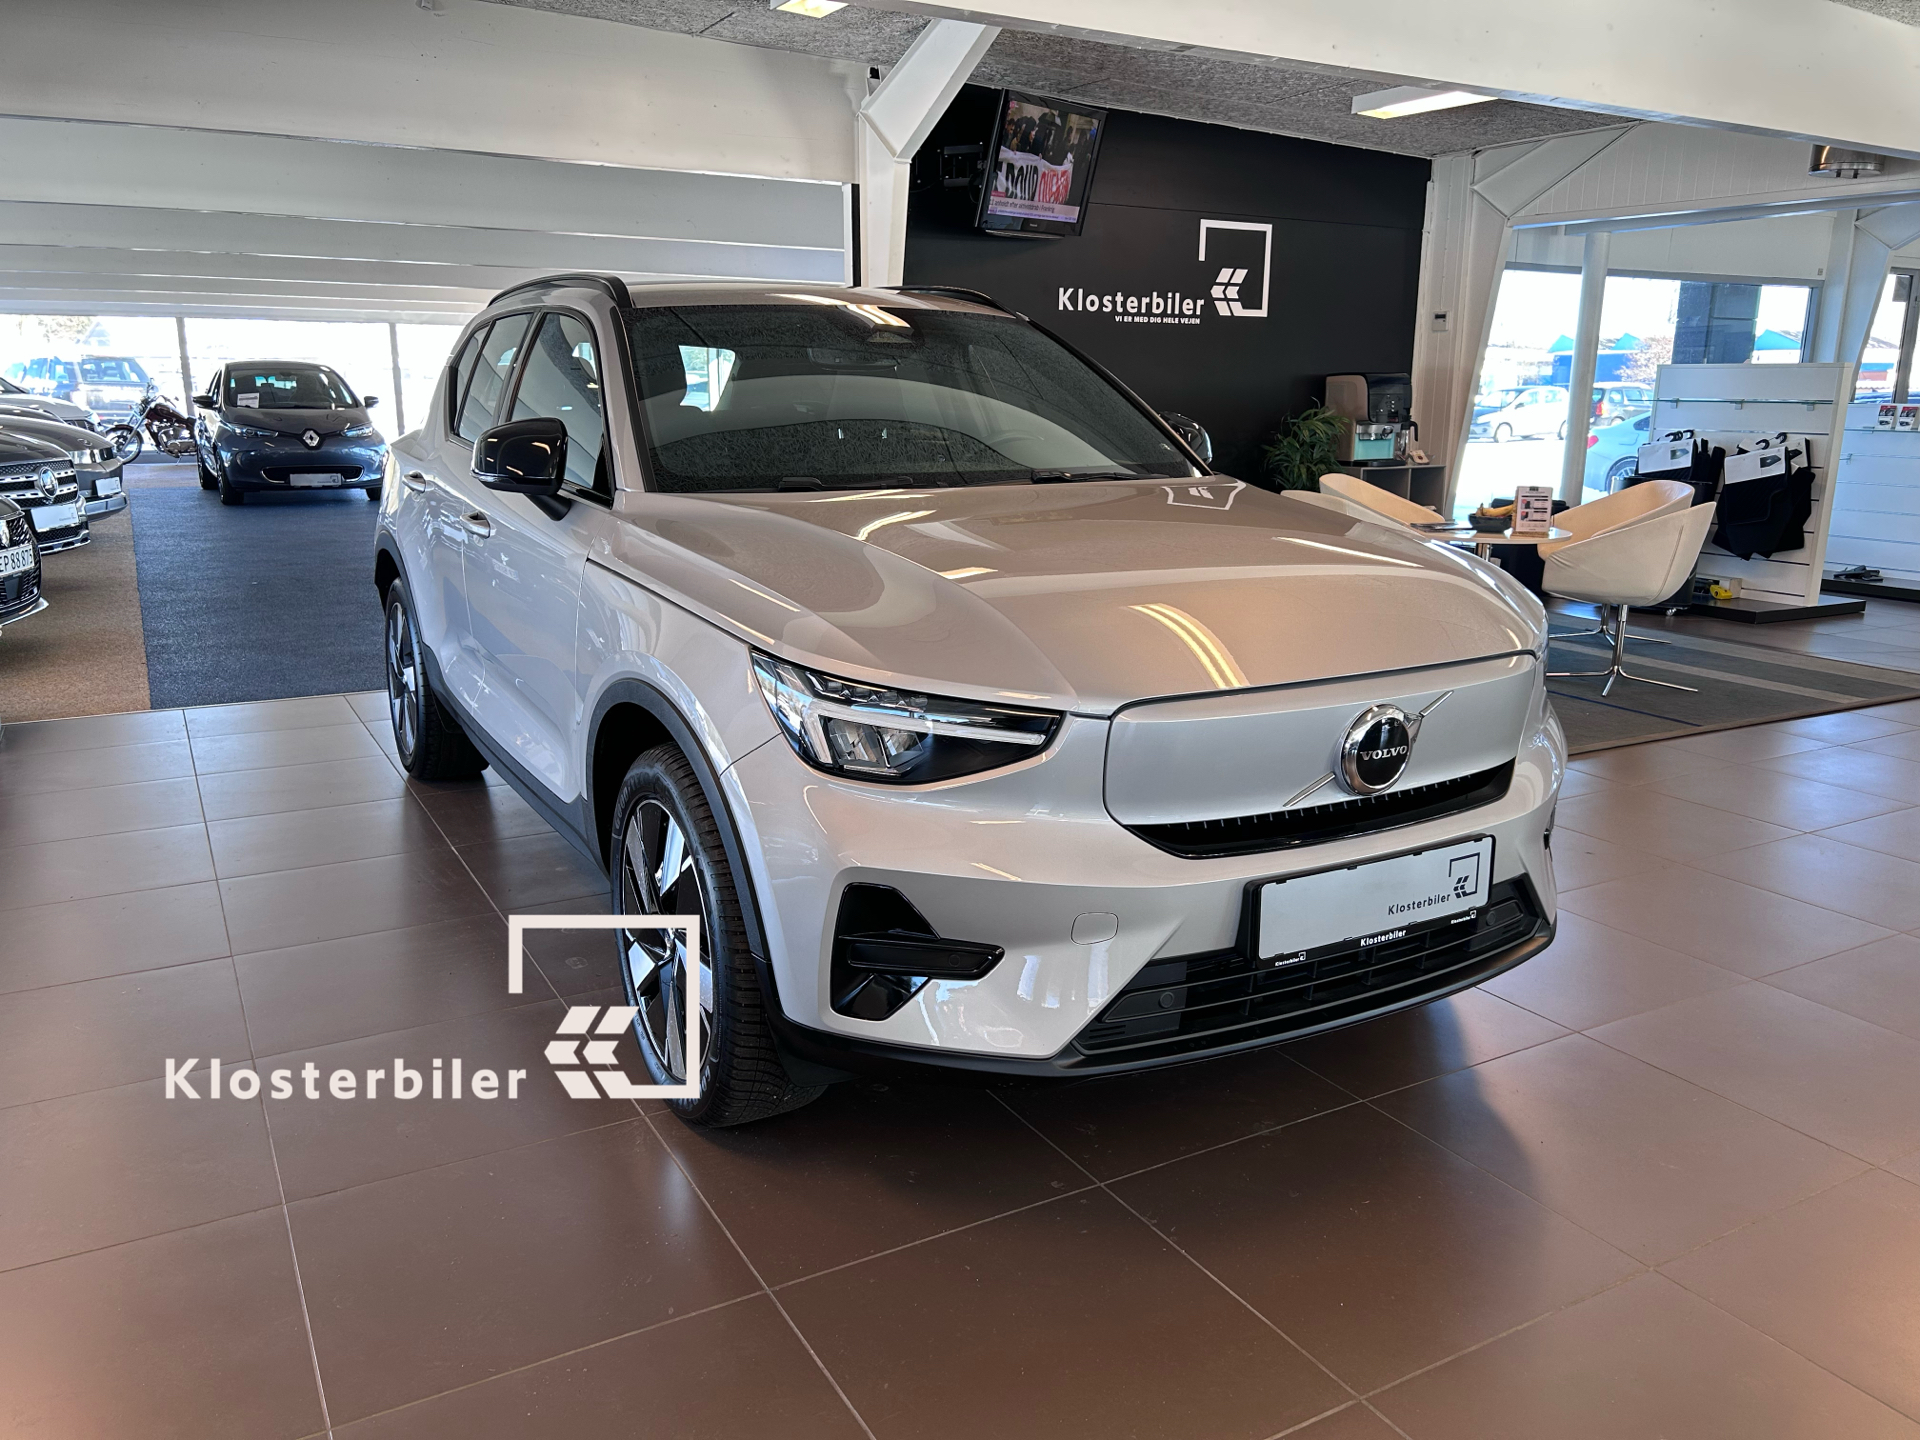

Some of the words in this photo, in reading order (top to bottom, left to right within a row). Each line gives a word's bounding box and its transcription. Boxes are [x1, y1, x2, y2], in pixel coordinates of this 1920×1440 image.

[1058, 287, 1205, 316] Klosterbiler
[10, 552, 21, 570] 88
[1360, 745, 1408, 761] VOLVO
[1388, 893, 1451, 916] Klosterbiler
[1361, 929, 1407, 947] Klosterbiler
